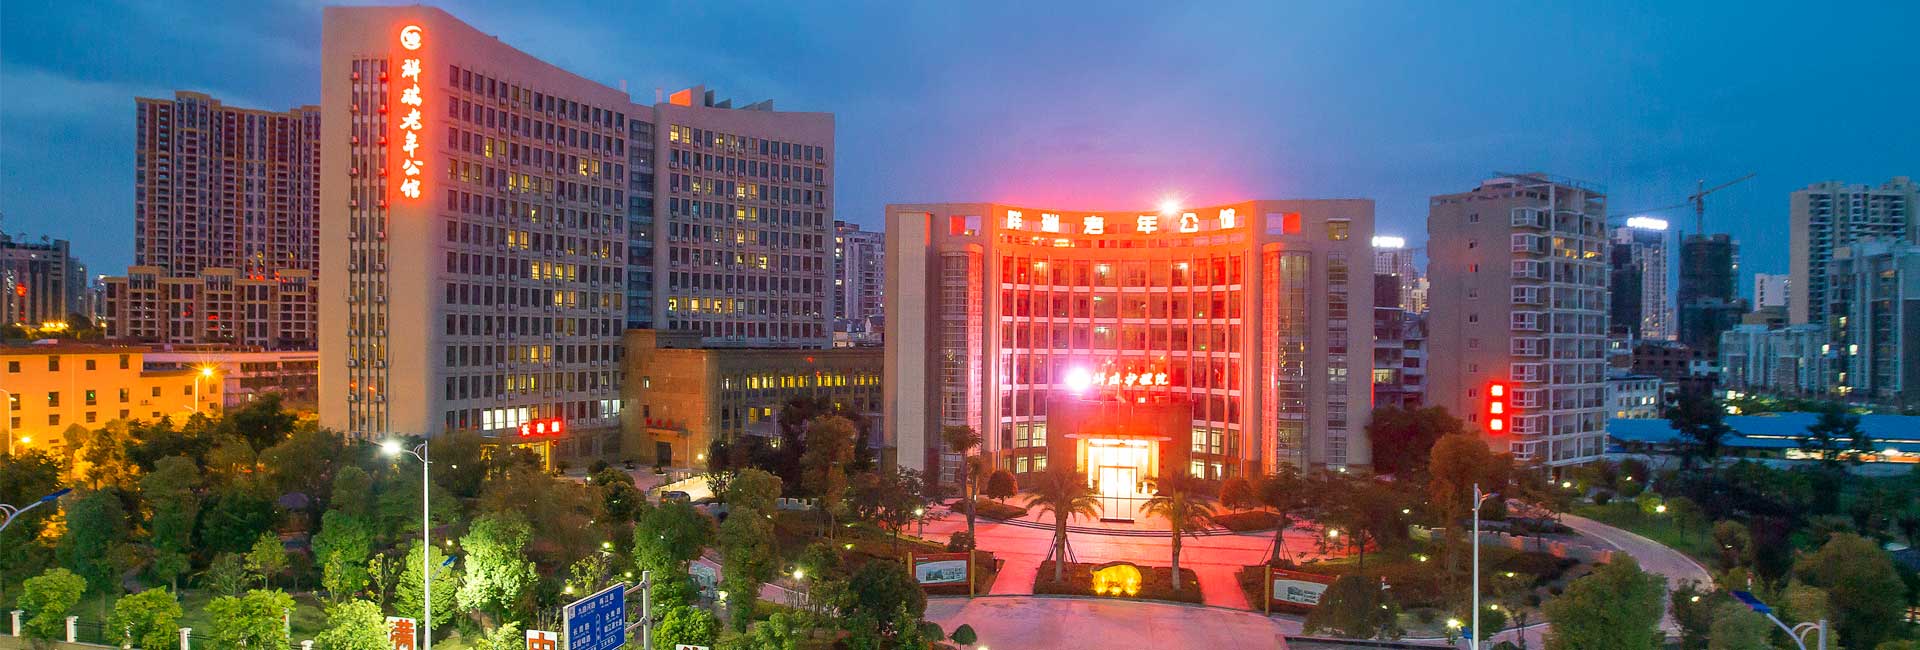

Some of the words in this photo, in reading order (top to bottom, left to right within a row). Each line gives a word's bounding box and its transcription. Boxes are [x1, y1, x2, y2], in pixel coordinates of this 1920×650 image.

[400, 59, 424, 199] 祥瑞老年公馆
[1007, 207, 1236, 235] 祥瑞老年公馆
